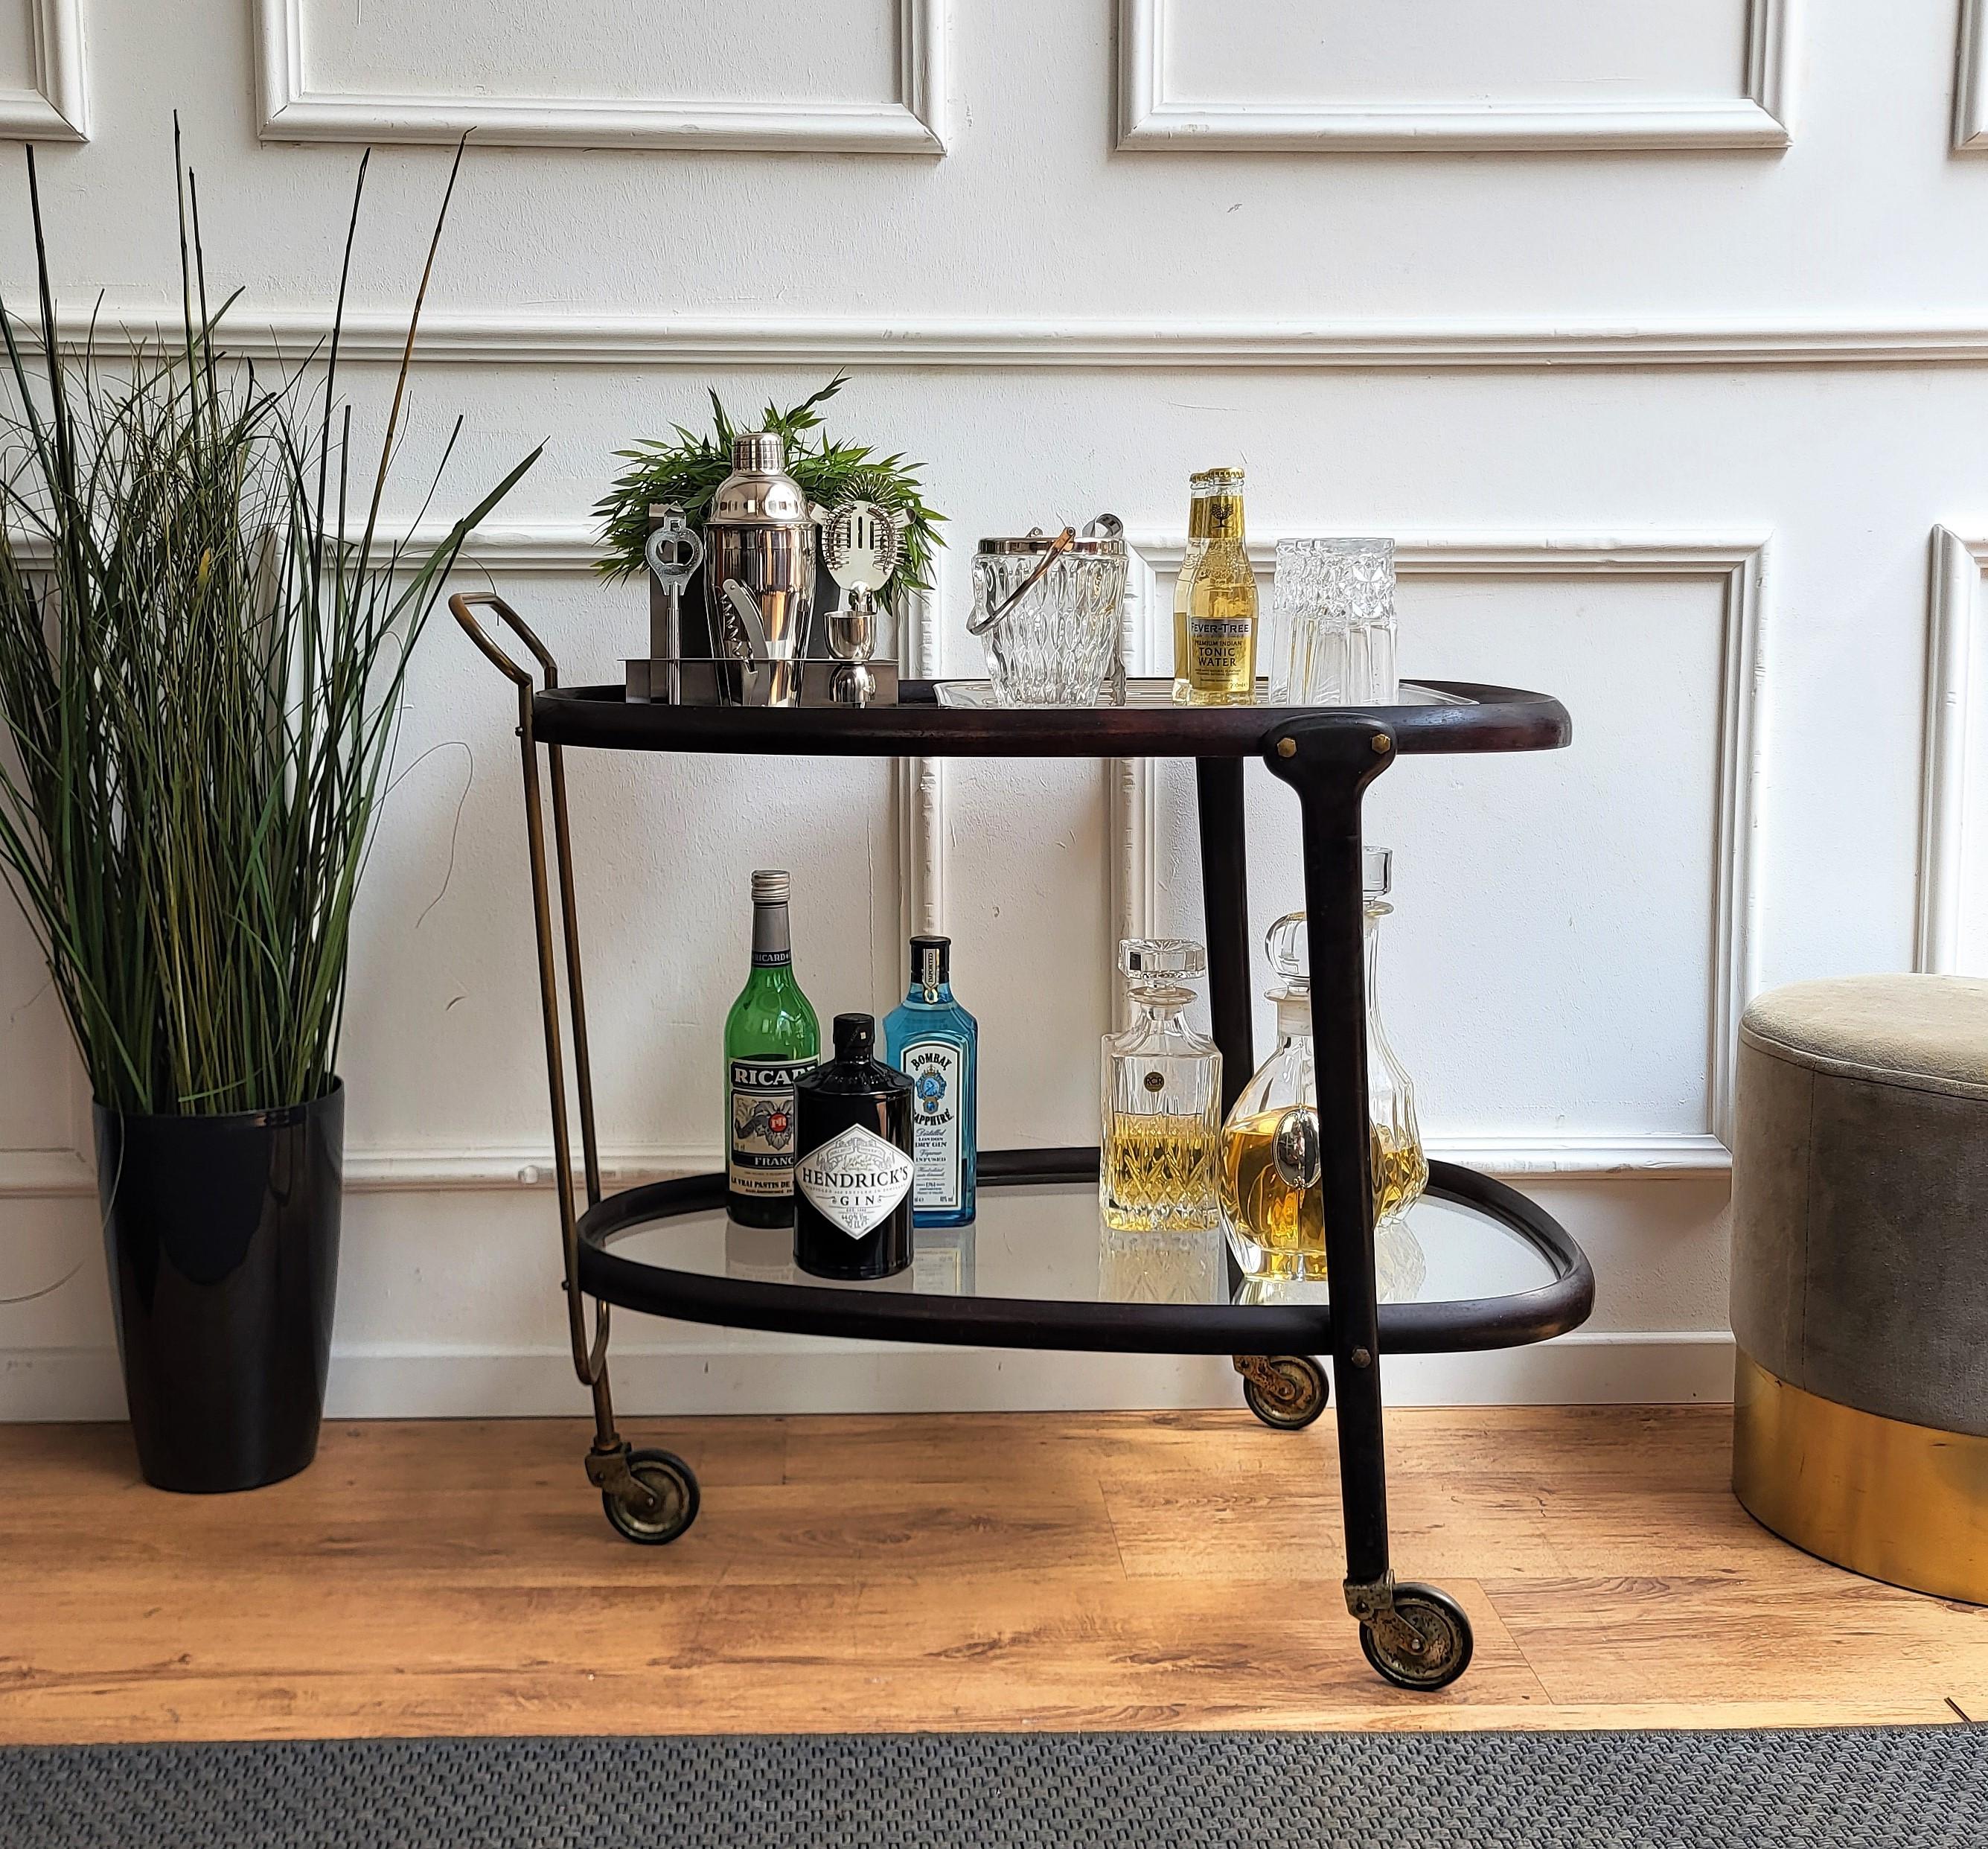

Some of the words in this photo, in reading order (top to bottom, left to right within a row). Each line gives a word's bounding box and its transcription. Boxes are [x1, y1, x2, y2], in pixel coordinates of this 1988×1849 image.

[1192, 622, 1249, 633] FEVER-TREE
[1199, 647, 1236, 657] TONIC
[1198, 657, 1237, 667] WATER
[911, 1053, 953, 1071] BOMBAY
[735, 1065, 816, 1085] RICA
[1145, 1076, 1163, 1085] RCR
[802, 1166, 908, 1188] HENDRICK'S
[840, 1195, 875, 1206] GIN
